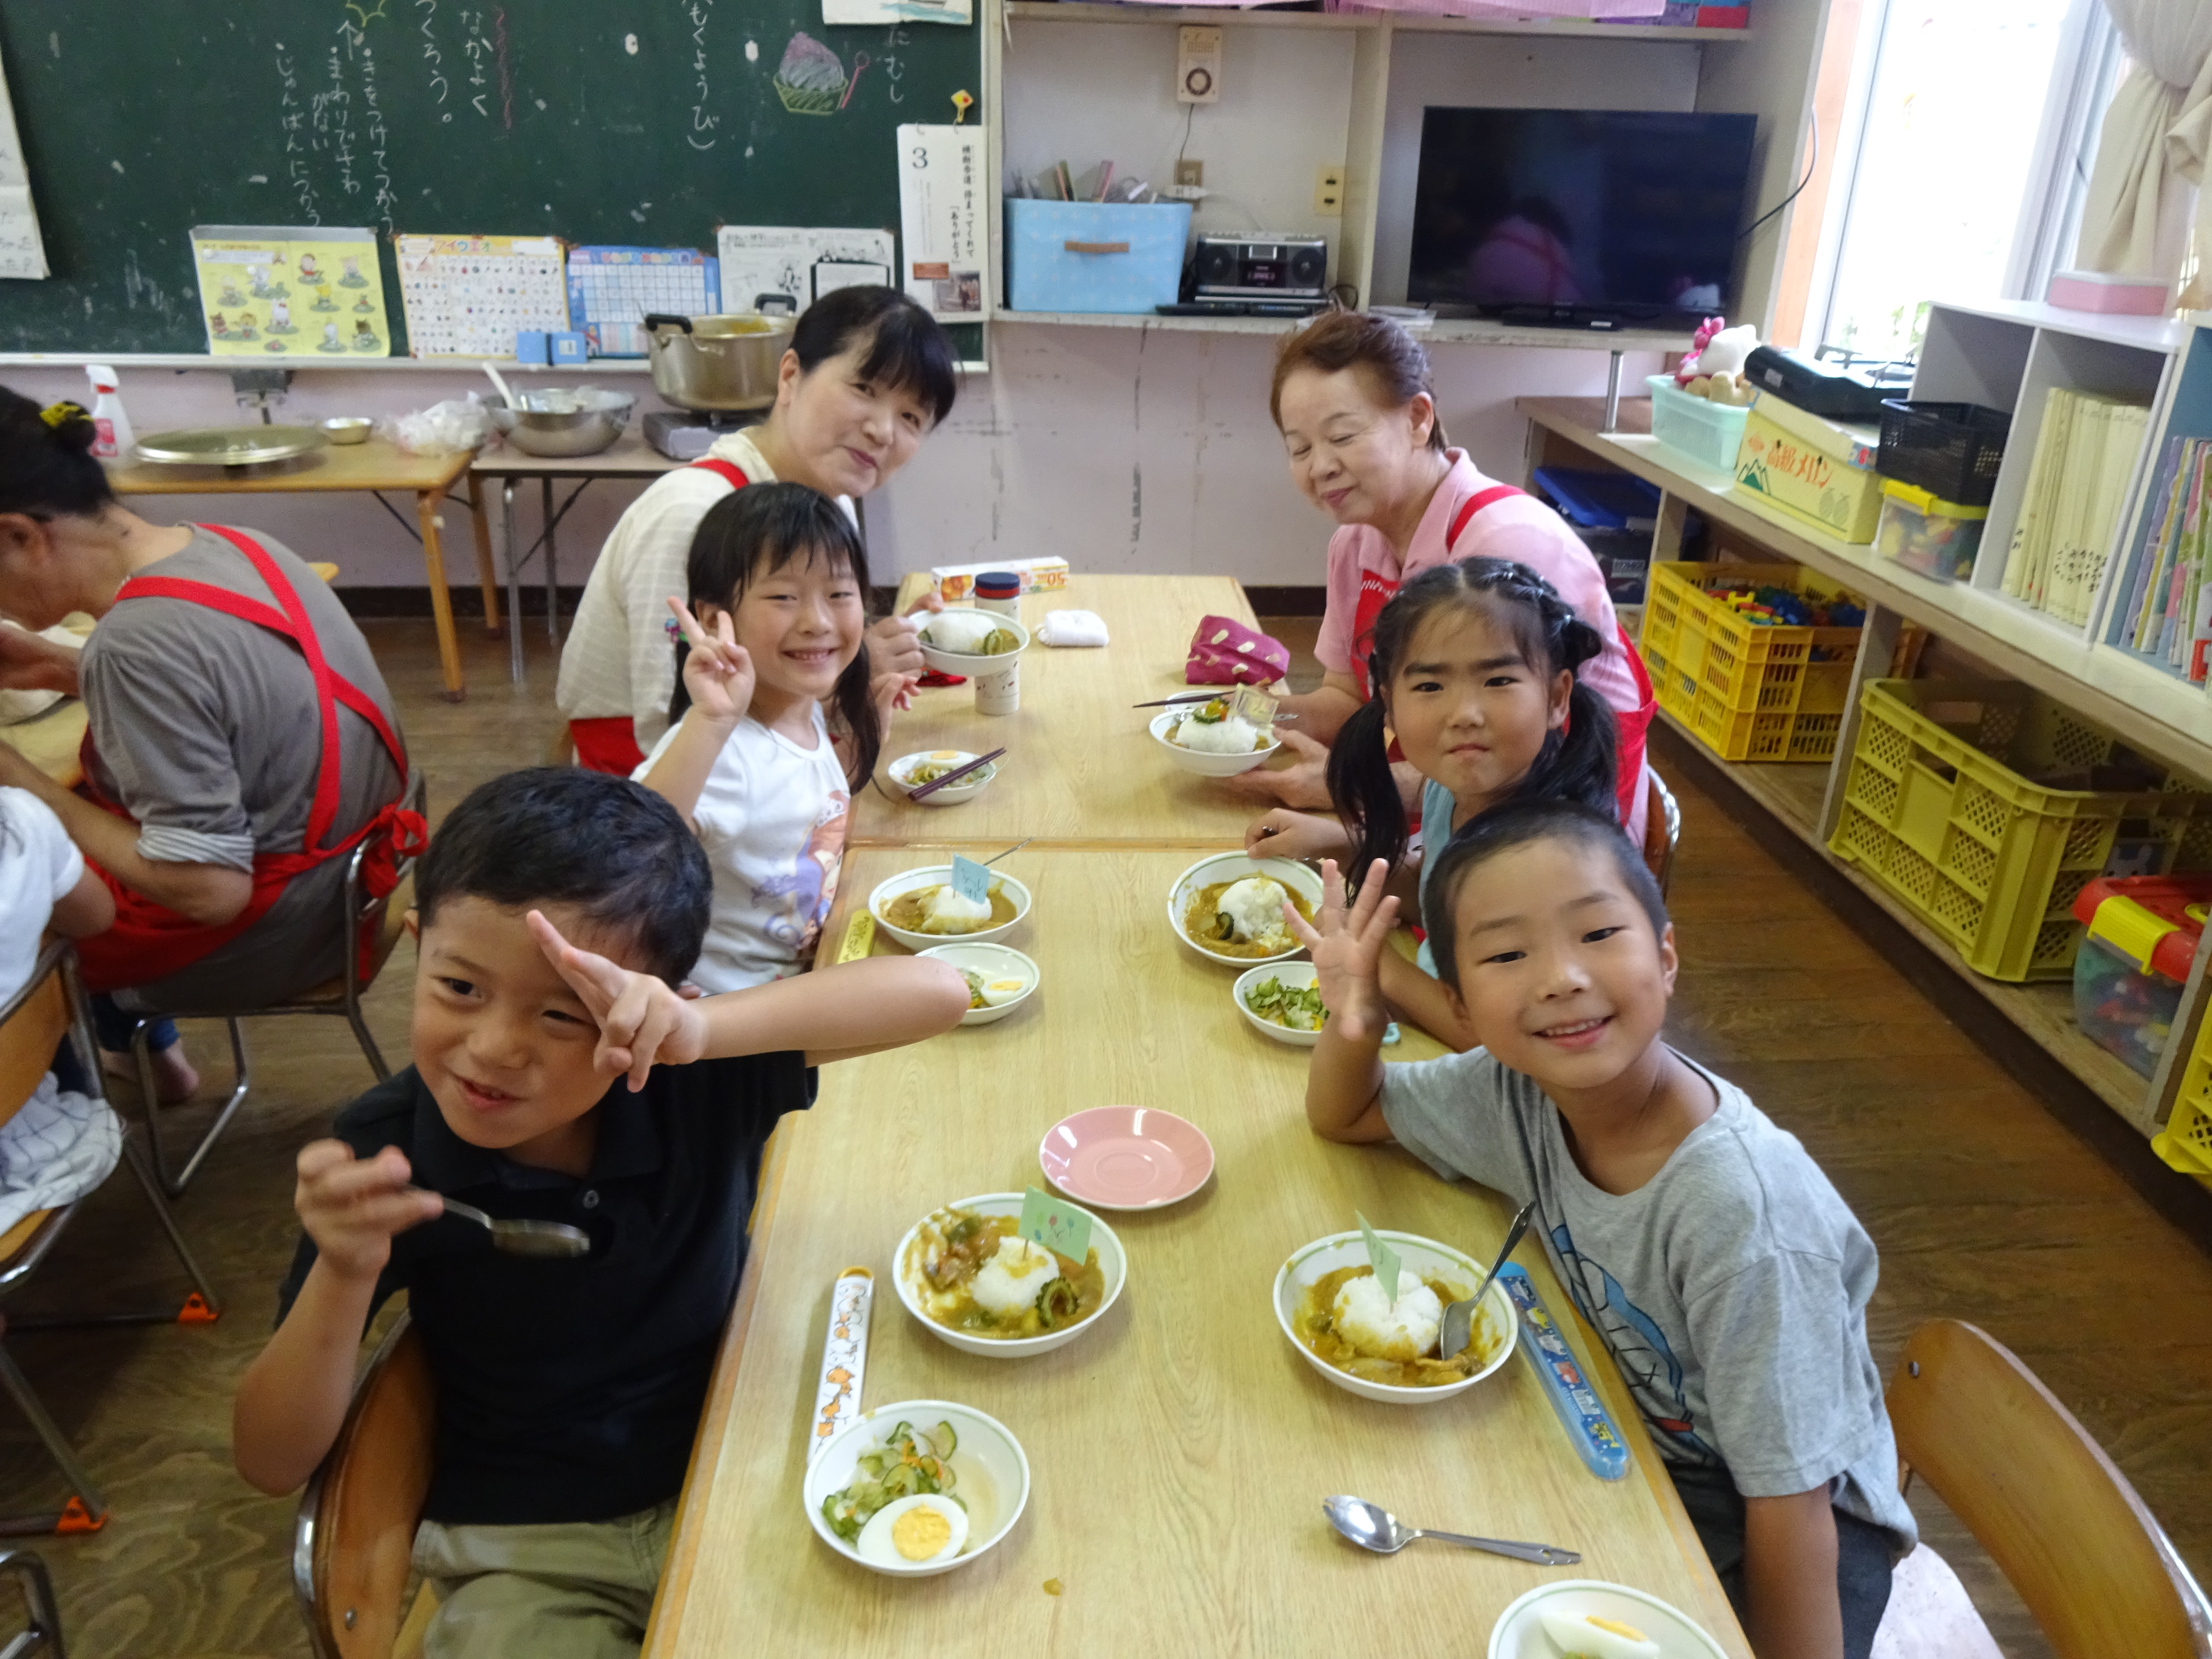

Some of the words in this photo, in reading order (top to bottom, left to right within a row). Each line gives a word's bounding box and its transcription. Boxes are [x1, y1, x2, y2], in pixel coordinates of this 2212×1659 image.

[415, 0, 453, 123] つくろう。
[459, 9, 494, 117] なかよく
[912, 146, 929, 169] 3
